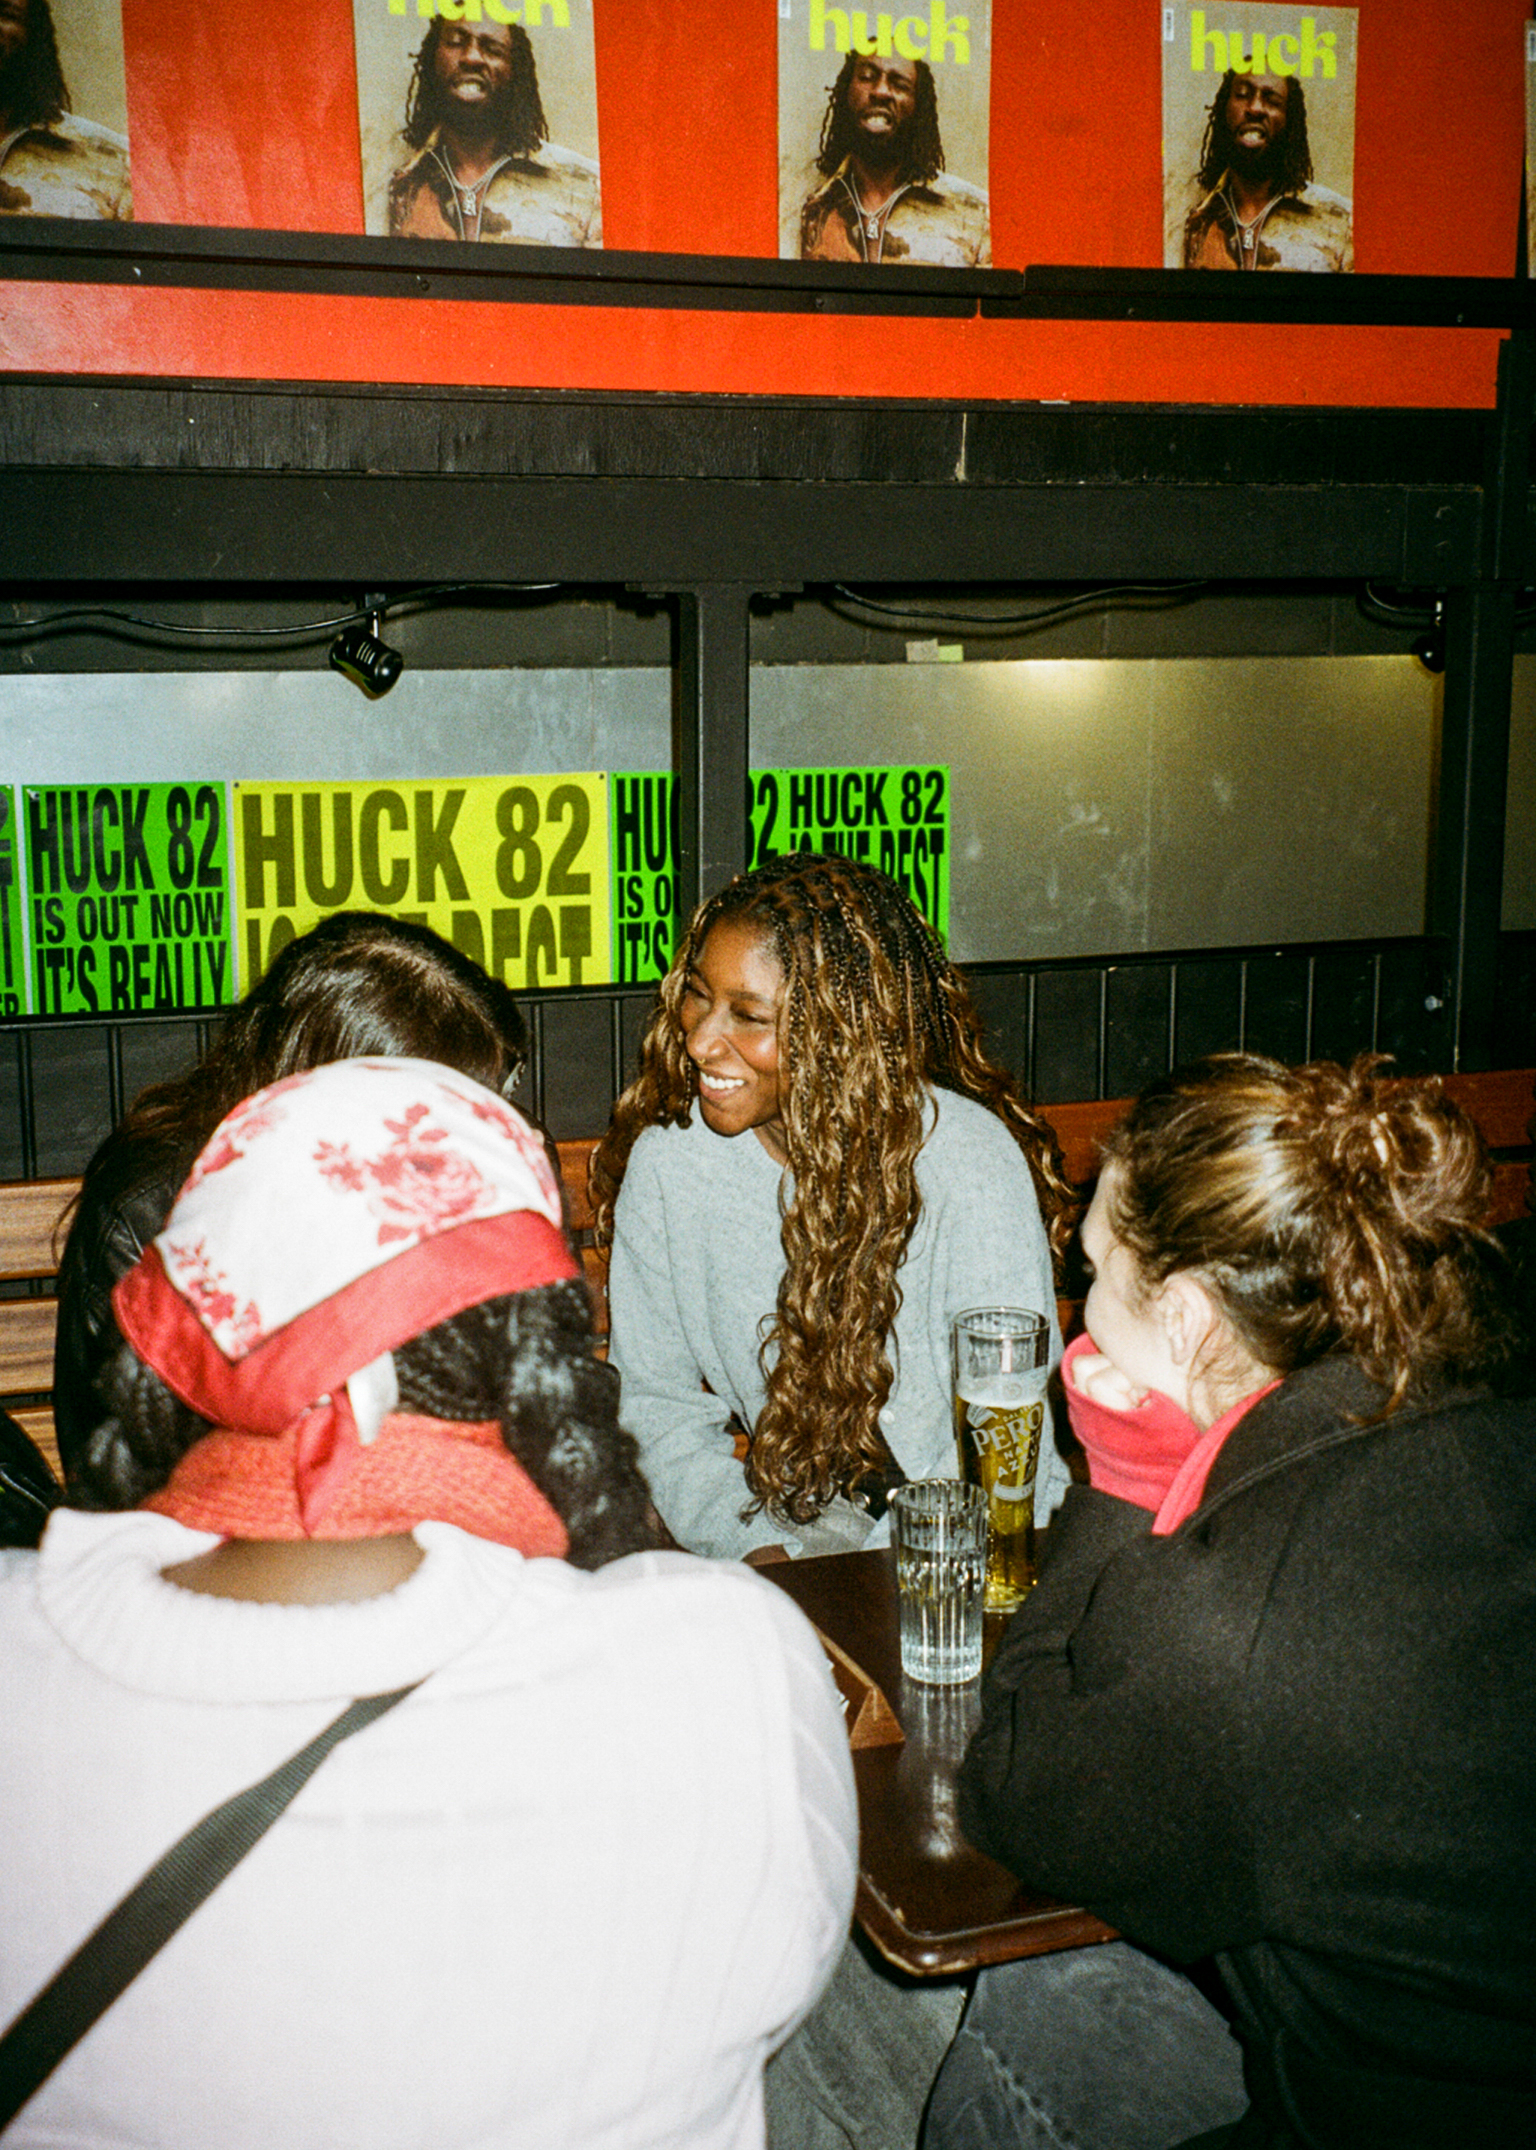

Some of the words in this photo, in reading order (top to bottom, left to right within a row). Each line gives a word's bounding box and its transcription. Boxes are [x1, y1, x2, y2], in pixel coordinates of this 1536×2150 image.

[809, 0, 971, 65] huck
[1190, 10, 1338, 79] huck
[616, 775, 682, 873] HU
[748, 772, 779, 867] 2
[790, 772, 889, 829] HUCK
[901, 770, 945, 825] 82
[29, 788, 156, 894] HUCK
[167, 786, 223, 890] 82
[240, 788, 471, 909] HUCK
[495, 784, 592, 900] 82
[33, 896, 66, 944] IS
[77, 894, 139, 942] OUT
[150, 891, 224, 939] NOW
[618, 874, 645, 919] IS
